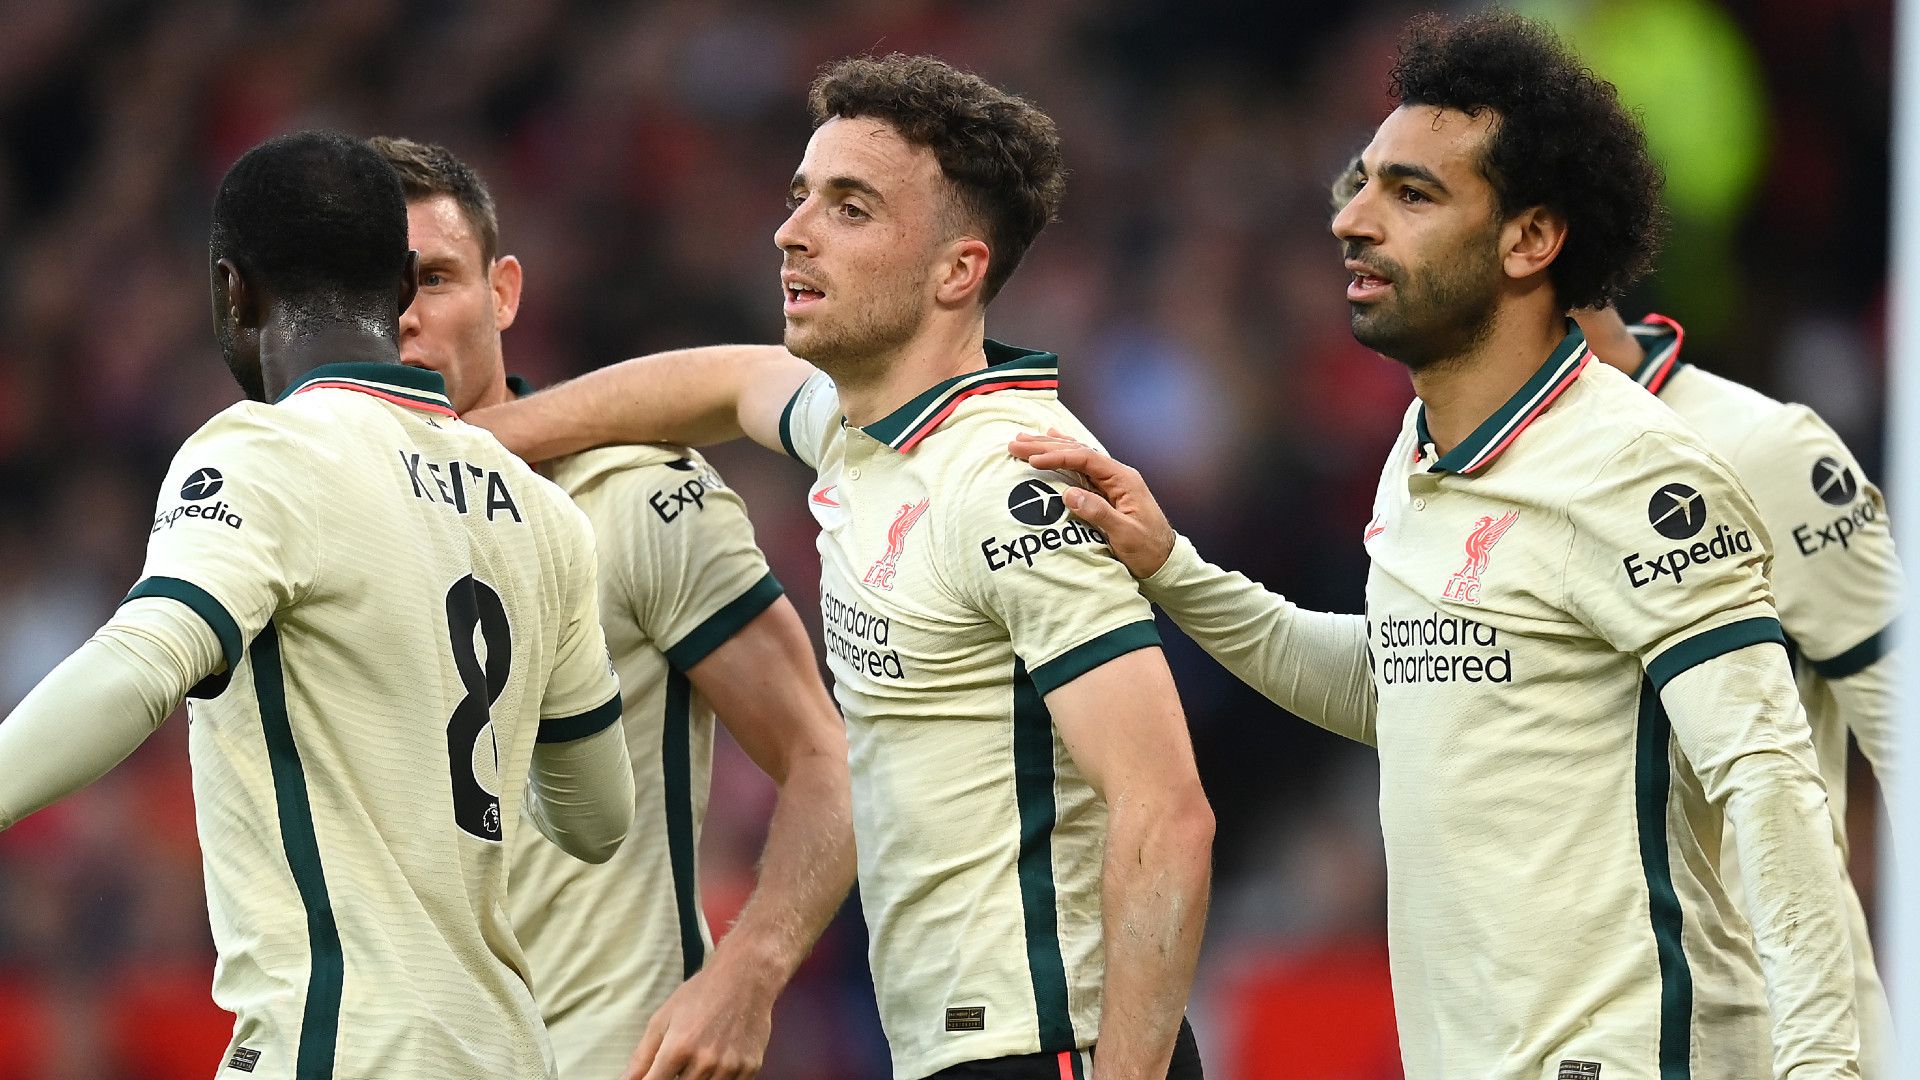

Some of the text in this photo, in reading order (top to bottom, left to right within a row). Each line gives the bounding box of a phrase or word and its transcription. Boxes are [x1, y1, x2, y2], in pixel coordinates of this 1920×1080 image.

[152, 501, 243, 533] Expedia
[1622, 524, 1753, 589] Expedia
[825, 588, 889, 647] standard
[1380, 612, 1497, 649] standard
[826, 624, 905, 680] chartered
[1384, 648, 1512, 685] chartered
[446, 573, 512, 841] 8
